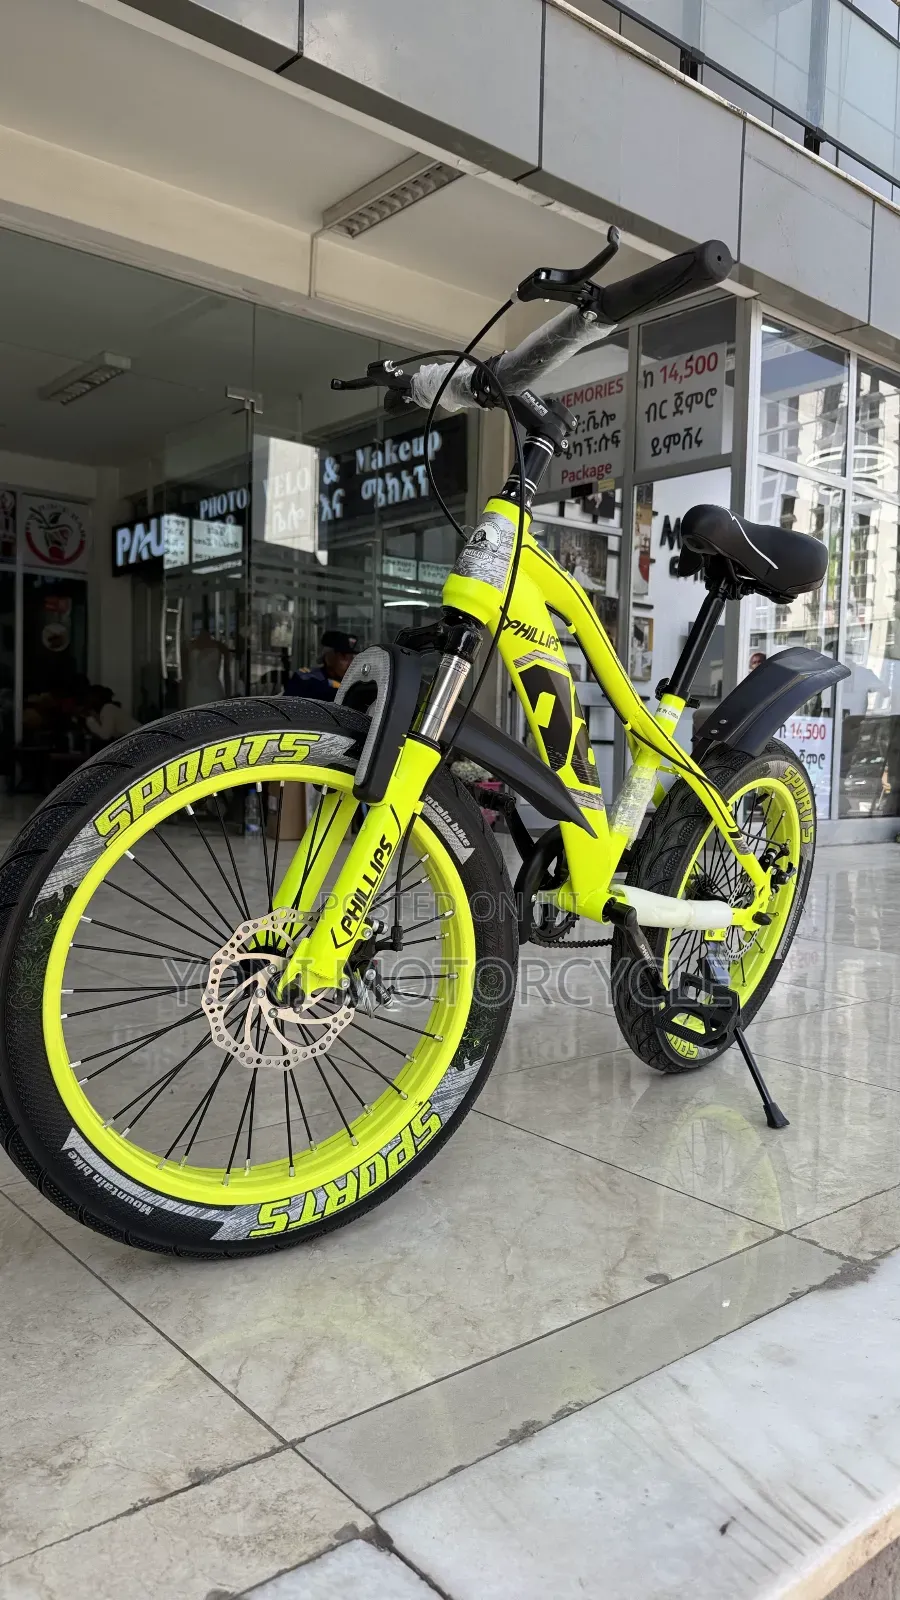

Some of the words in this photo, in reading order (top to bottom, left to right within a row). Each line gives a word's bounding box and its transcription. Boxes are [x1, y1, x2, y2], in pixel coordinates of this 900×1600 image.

[660, 352, 718, 384] 14,500
[645, 400, 668, 423] ብር
[200, 488, 248, 519] PHOTO
[263, 467, 312, 500] VELO
[323, 456, 340, 485] &
[355, 431, 442, 474] Makeup
[561, 463, 612, 484] Package
[502, 619, 559, 651] PHILLIPS
[790, 723, 826, 742] 14,500
[92, 732, 322, 848] SPORTS
[778, 764, 815, 845] SPORTS
[450, 822, 471, 846] bike
[340, 834, 393, 937] PHILLIPS
[67, 1149, 94, 1177] bike
[249, 1100, 443, 1238] SPORTS
[92, 1173, 155, 1216] Mountain
